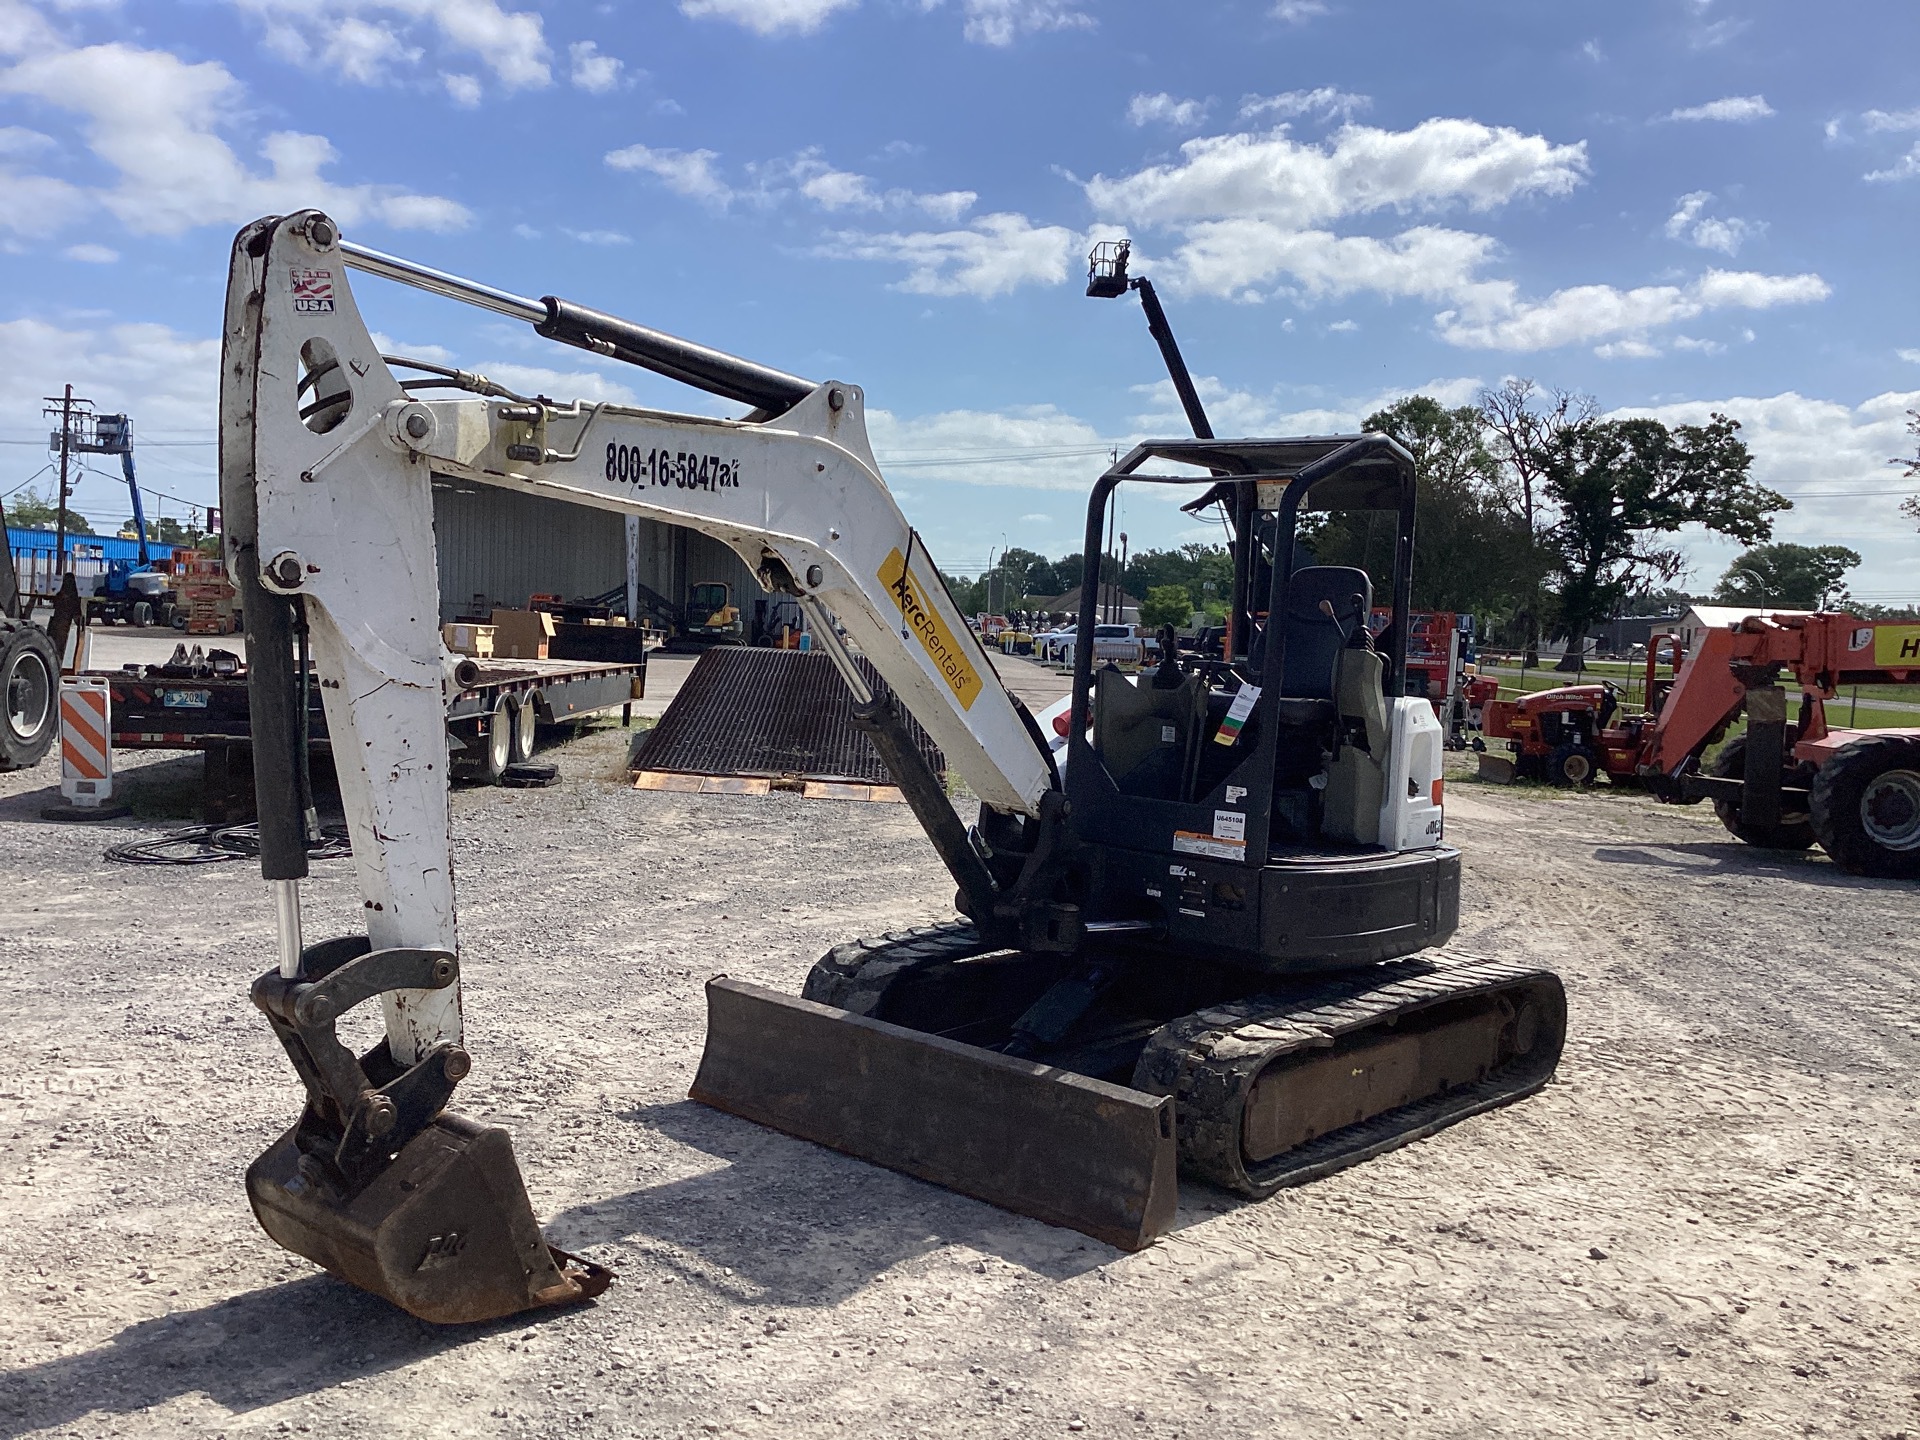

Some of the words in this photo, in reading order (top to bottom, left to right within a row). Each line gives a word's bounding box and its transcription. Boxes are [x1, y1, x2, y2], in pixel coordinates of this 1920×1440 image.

[297, 300, 332, 311] USA
[1546, 693, 1564, 701] Ditch
[1216, 815, 1244, 824] U645108
